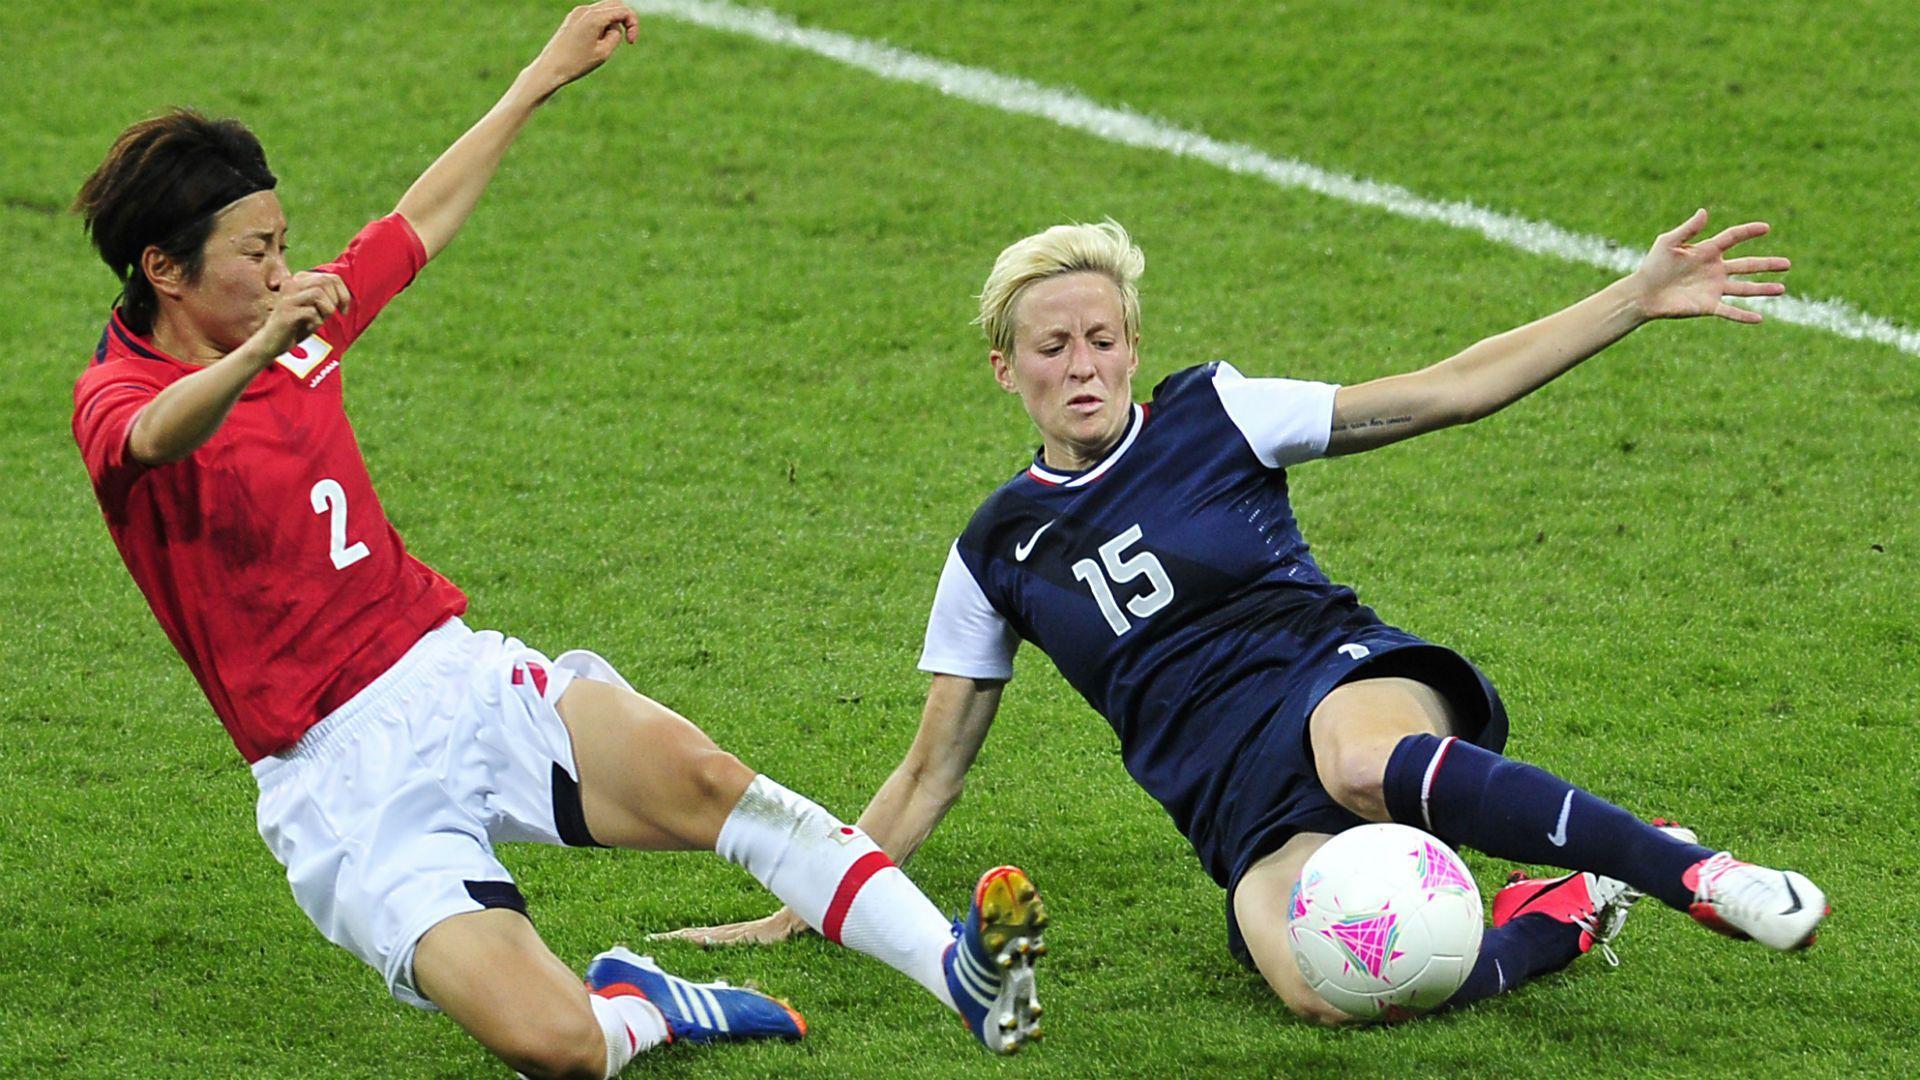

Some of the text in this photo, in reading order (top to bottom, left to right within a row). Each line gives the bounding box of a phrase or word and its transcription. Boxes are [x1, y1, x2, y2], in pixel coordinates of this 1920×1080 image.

[309, 359, 340, 388] JAPAN
[310, 478, 371, 571] 2
[1071, 523, 1175, 637] 15
